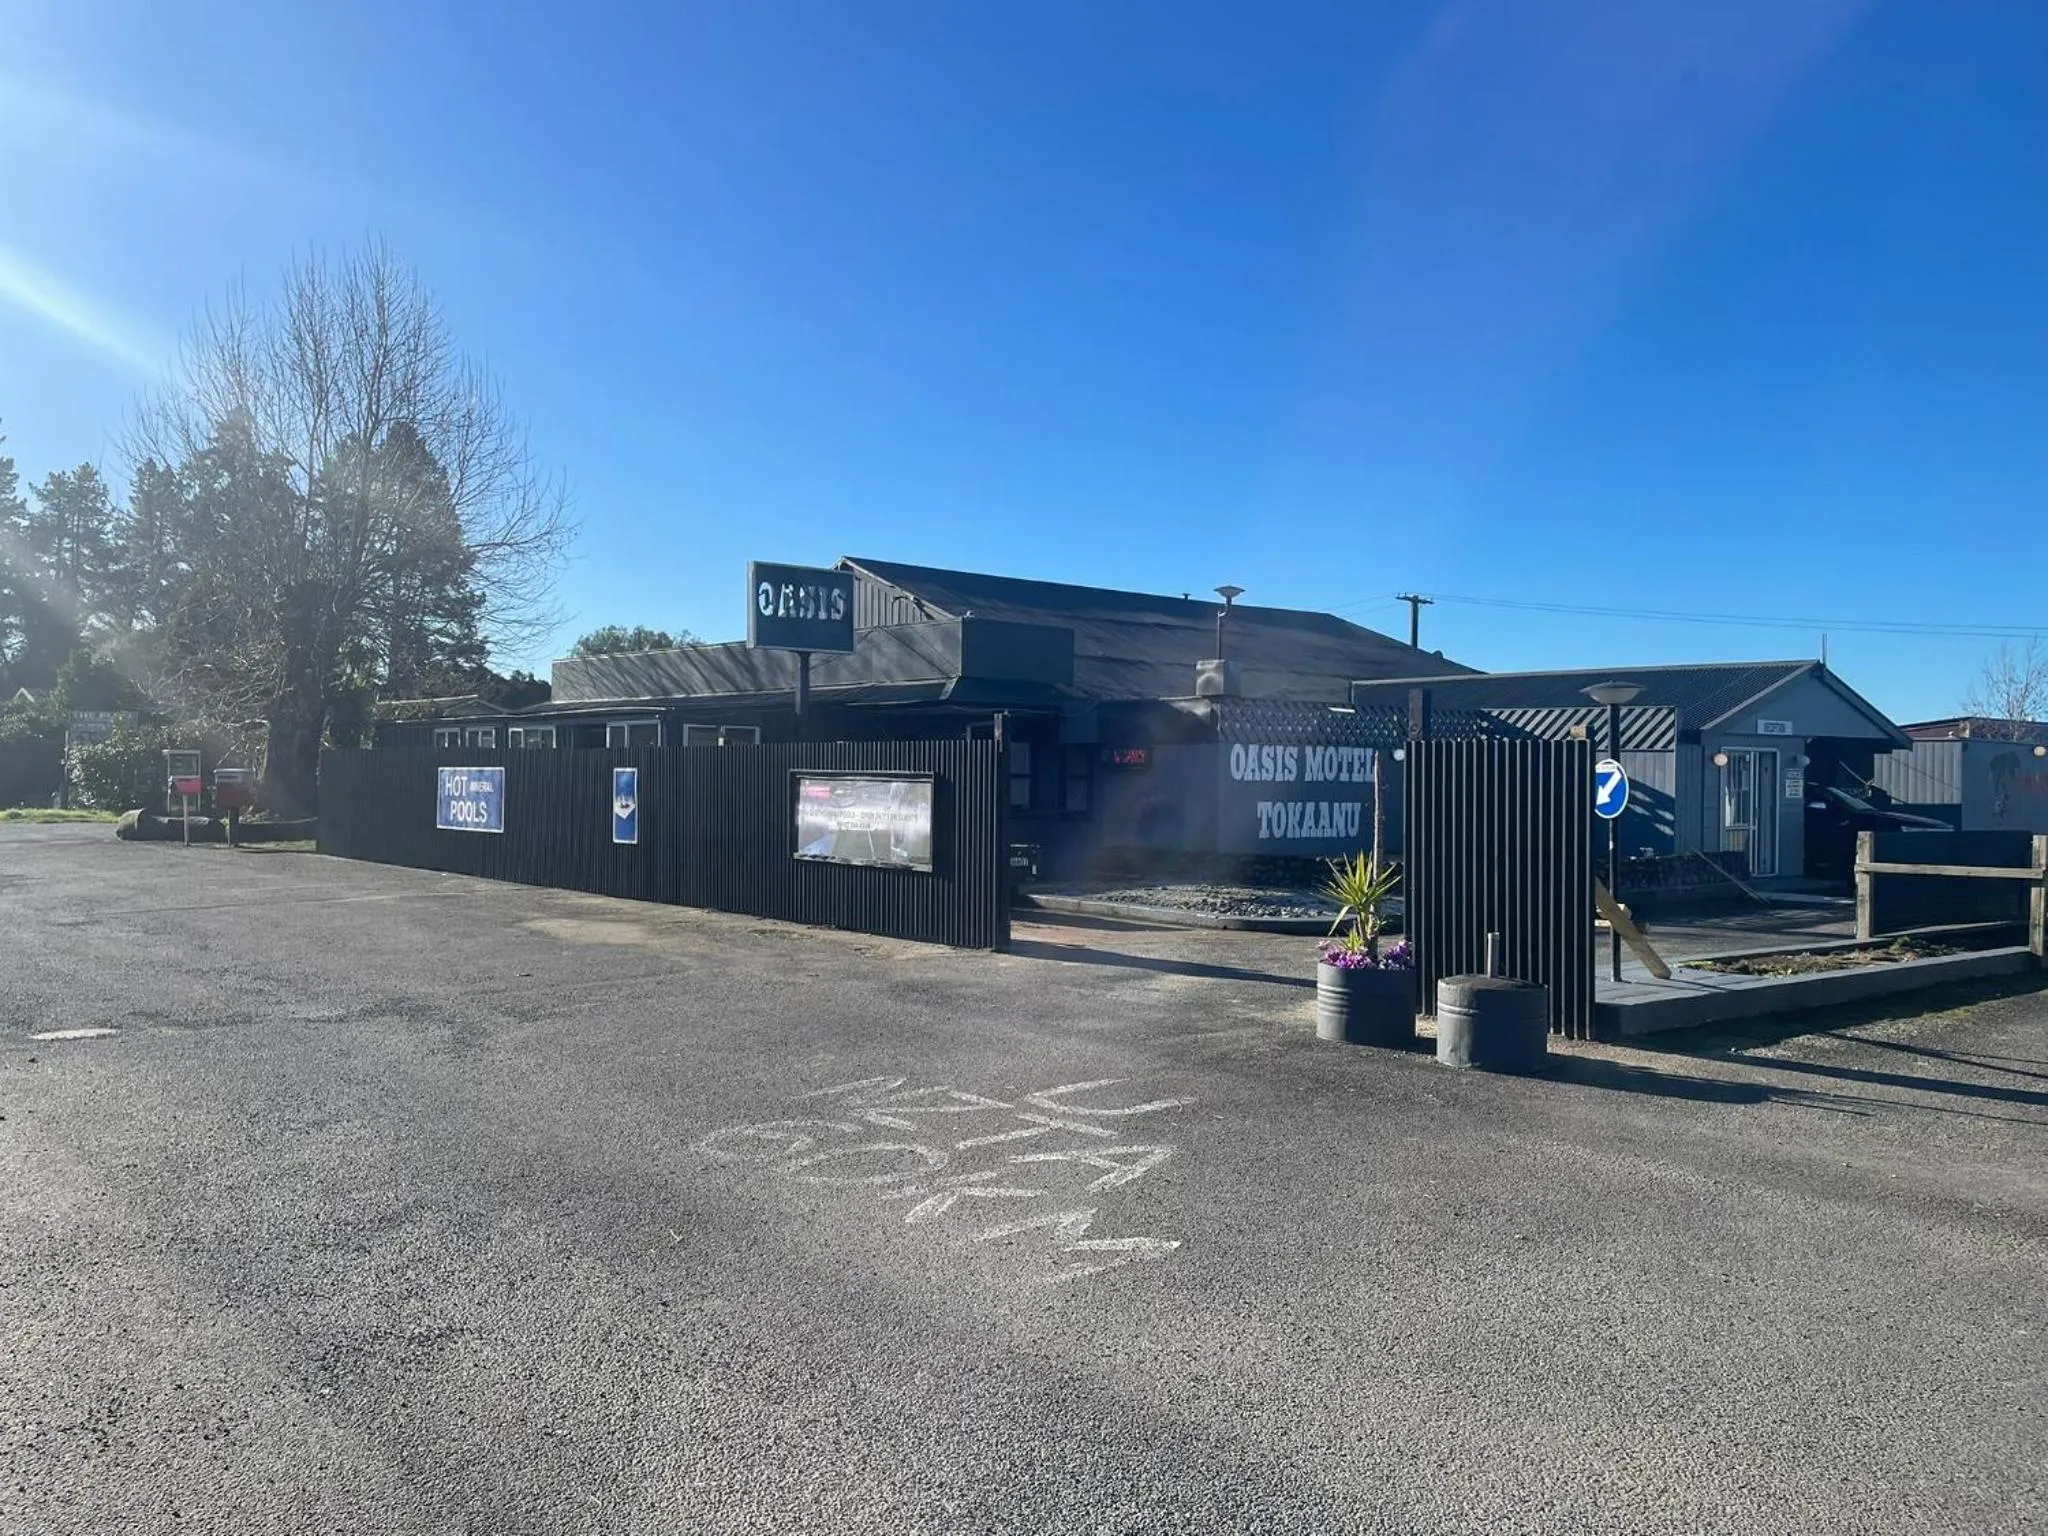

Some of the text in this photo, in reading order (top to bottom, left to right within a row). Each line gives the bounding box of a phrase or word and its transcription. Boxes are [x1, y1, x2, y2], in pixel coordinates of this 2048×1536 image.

[758, 581, 845, 620] OASIS
[1230, 743, 1375, 782] OASIS MOTEL
[445, 775, 494, 797] HOT ERAL
[450, 800, 487, 823] POOLS
[1256, 801, 1361, 838] TOKAANU
